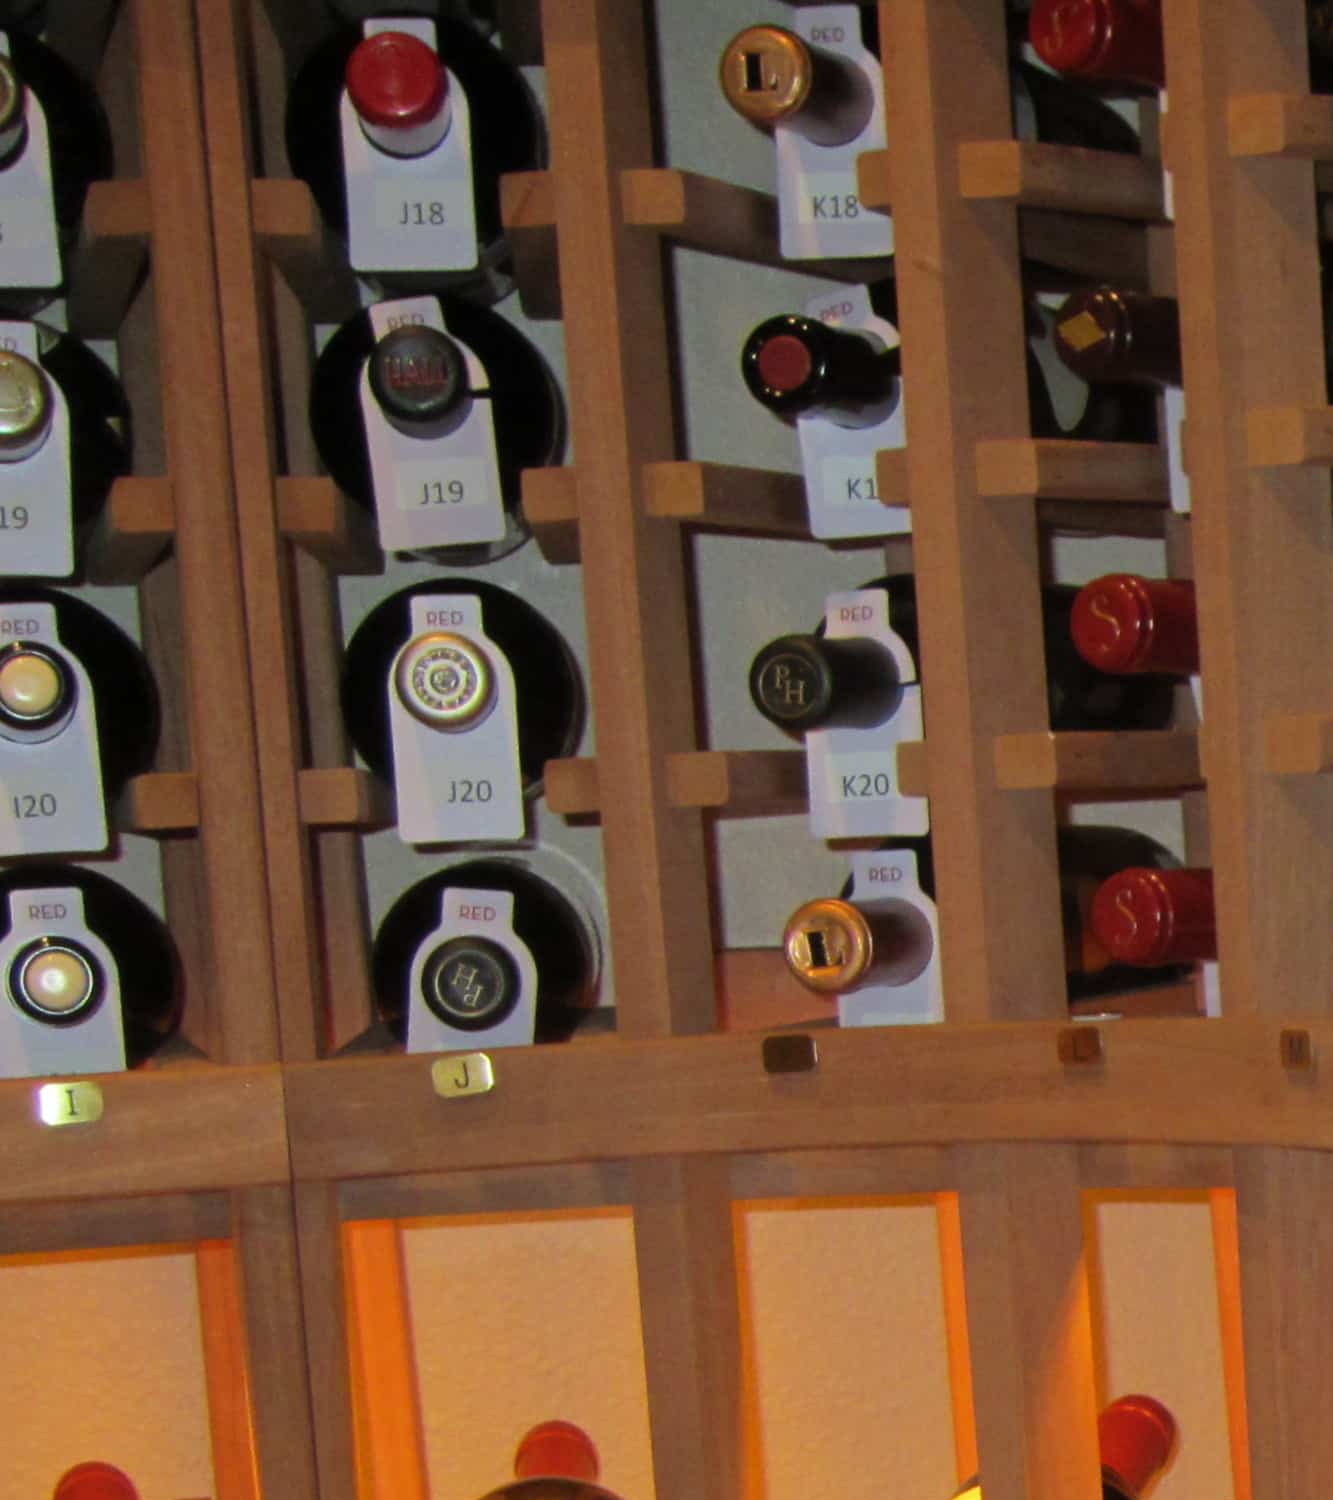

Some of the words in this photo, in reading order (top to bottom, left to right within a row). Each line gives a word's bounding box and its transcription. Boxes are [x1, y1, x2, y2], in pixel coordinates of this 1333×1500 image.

[398, 201, 446, 226] J18
[812, 194, 860, 219] K18
[419, 481, 465, 505] J19
[846, 477, 880, 500] K1
[0, 506, 29, 529] 19
[425, 610, 464, 627] RED
[840, 606, 873, 622] RED
[1, 618, 40, 636] RED
[447, 779, 493, 804] J20
[842, 772, 890, 798] K20
[13, 792, 58, 820] I20
[867, 866, 904, 883] RED
[28, 903, 68, 921] RED
[458, 903, 497, 921] RED
[453, 1060, 471, 1090] J
